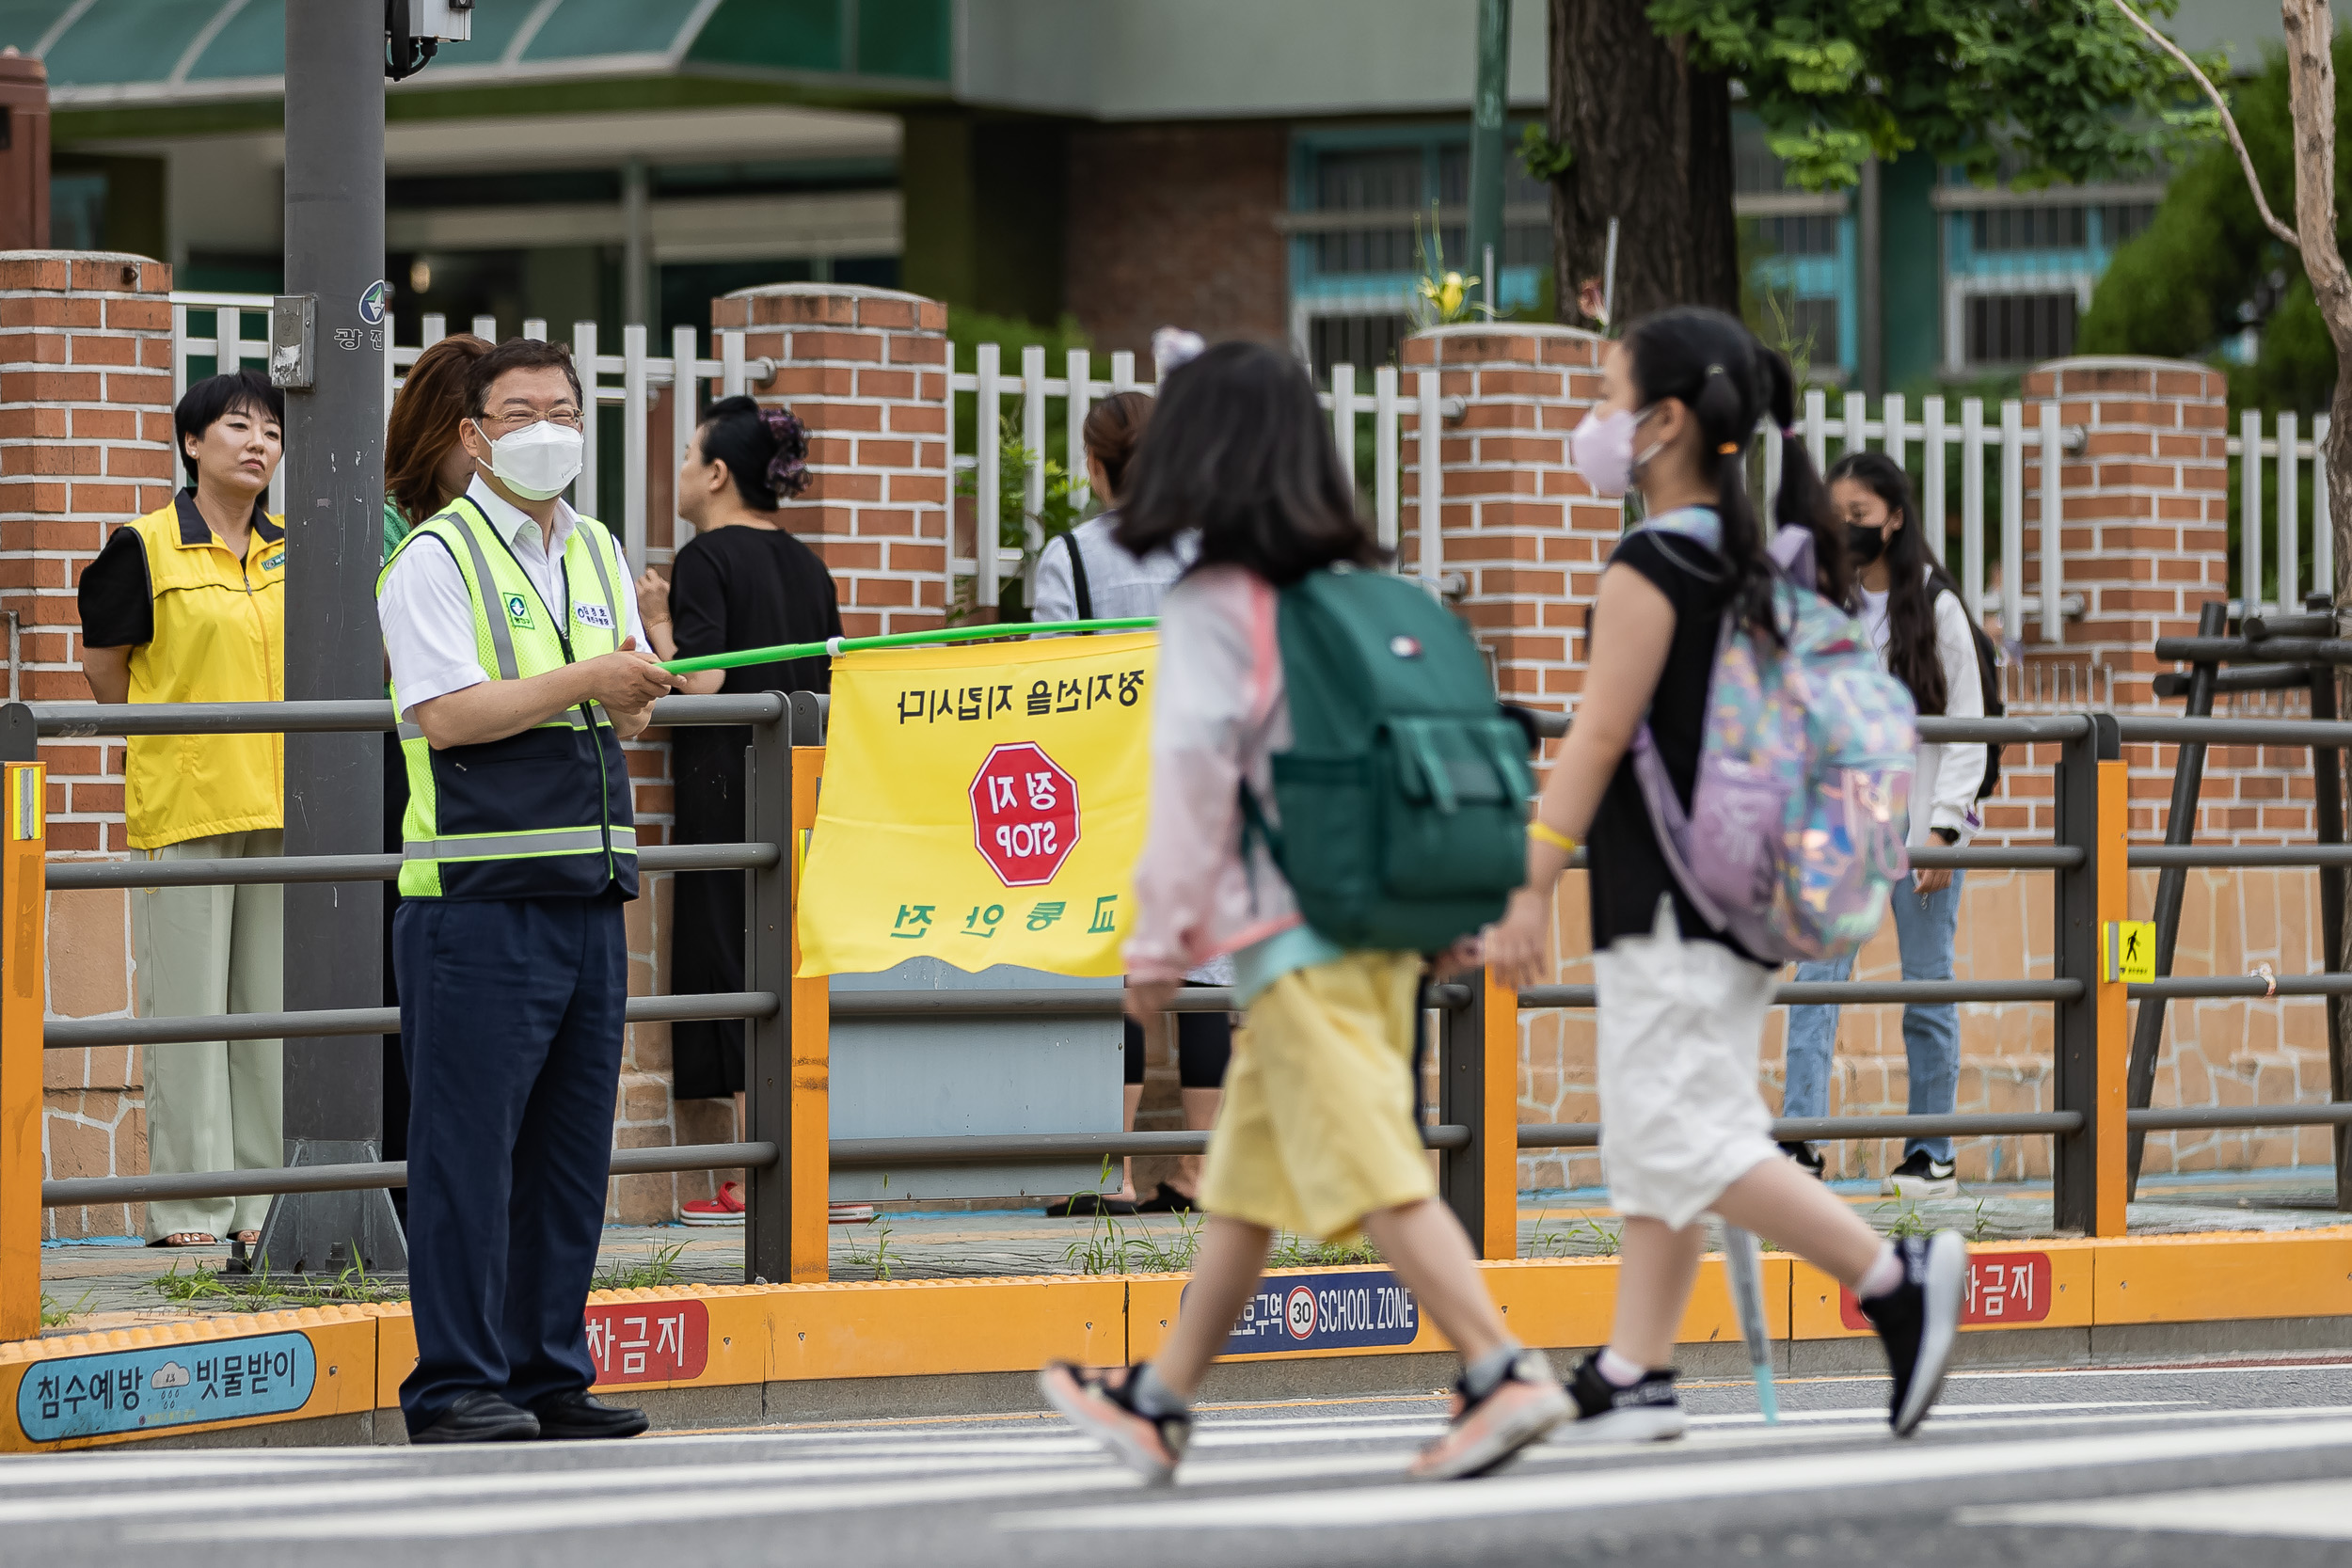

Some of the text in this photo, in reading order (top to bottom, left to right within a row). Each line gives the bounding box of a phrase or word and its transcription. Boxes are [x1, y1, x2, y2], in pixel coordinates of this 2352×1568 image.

[1293, 1302, 1311, 1324] 30
[1319, 1288, 1375, 1333] SCHOOL
[1376, 1287, 1413, 1329] ZONE
[38, 1347, 295, 1420] 침수예방 빗물받이
